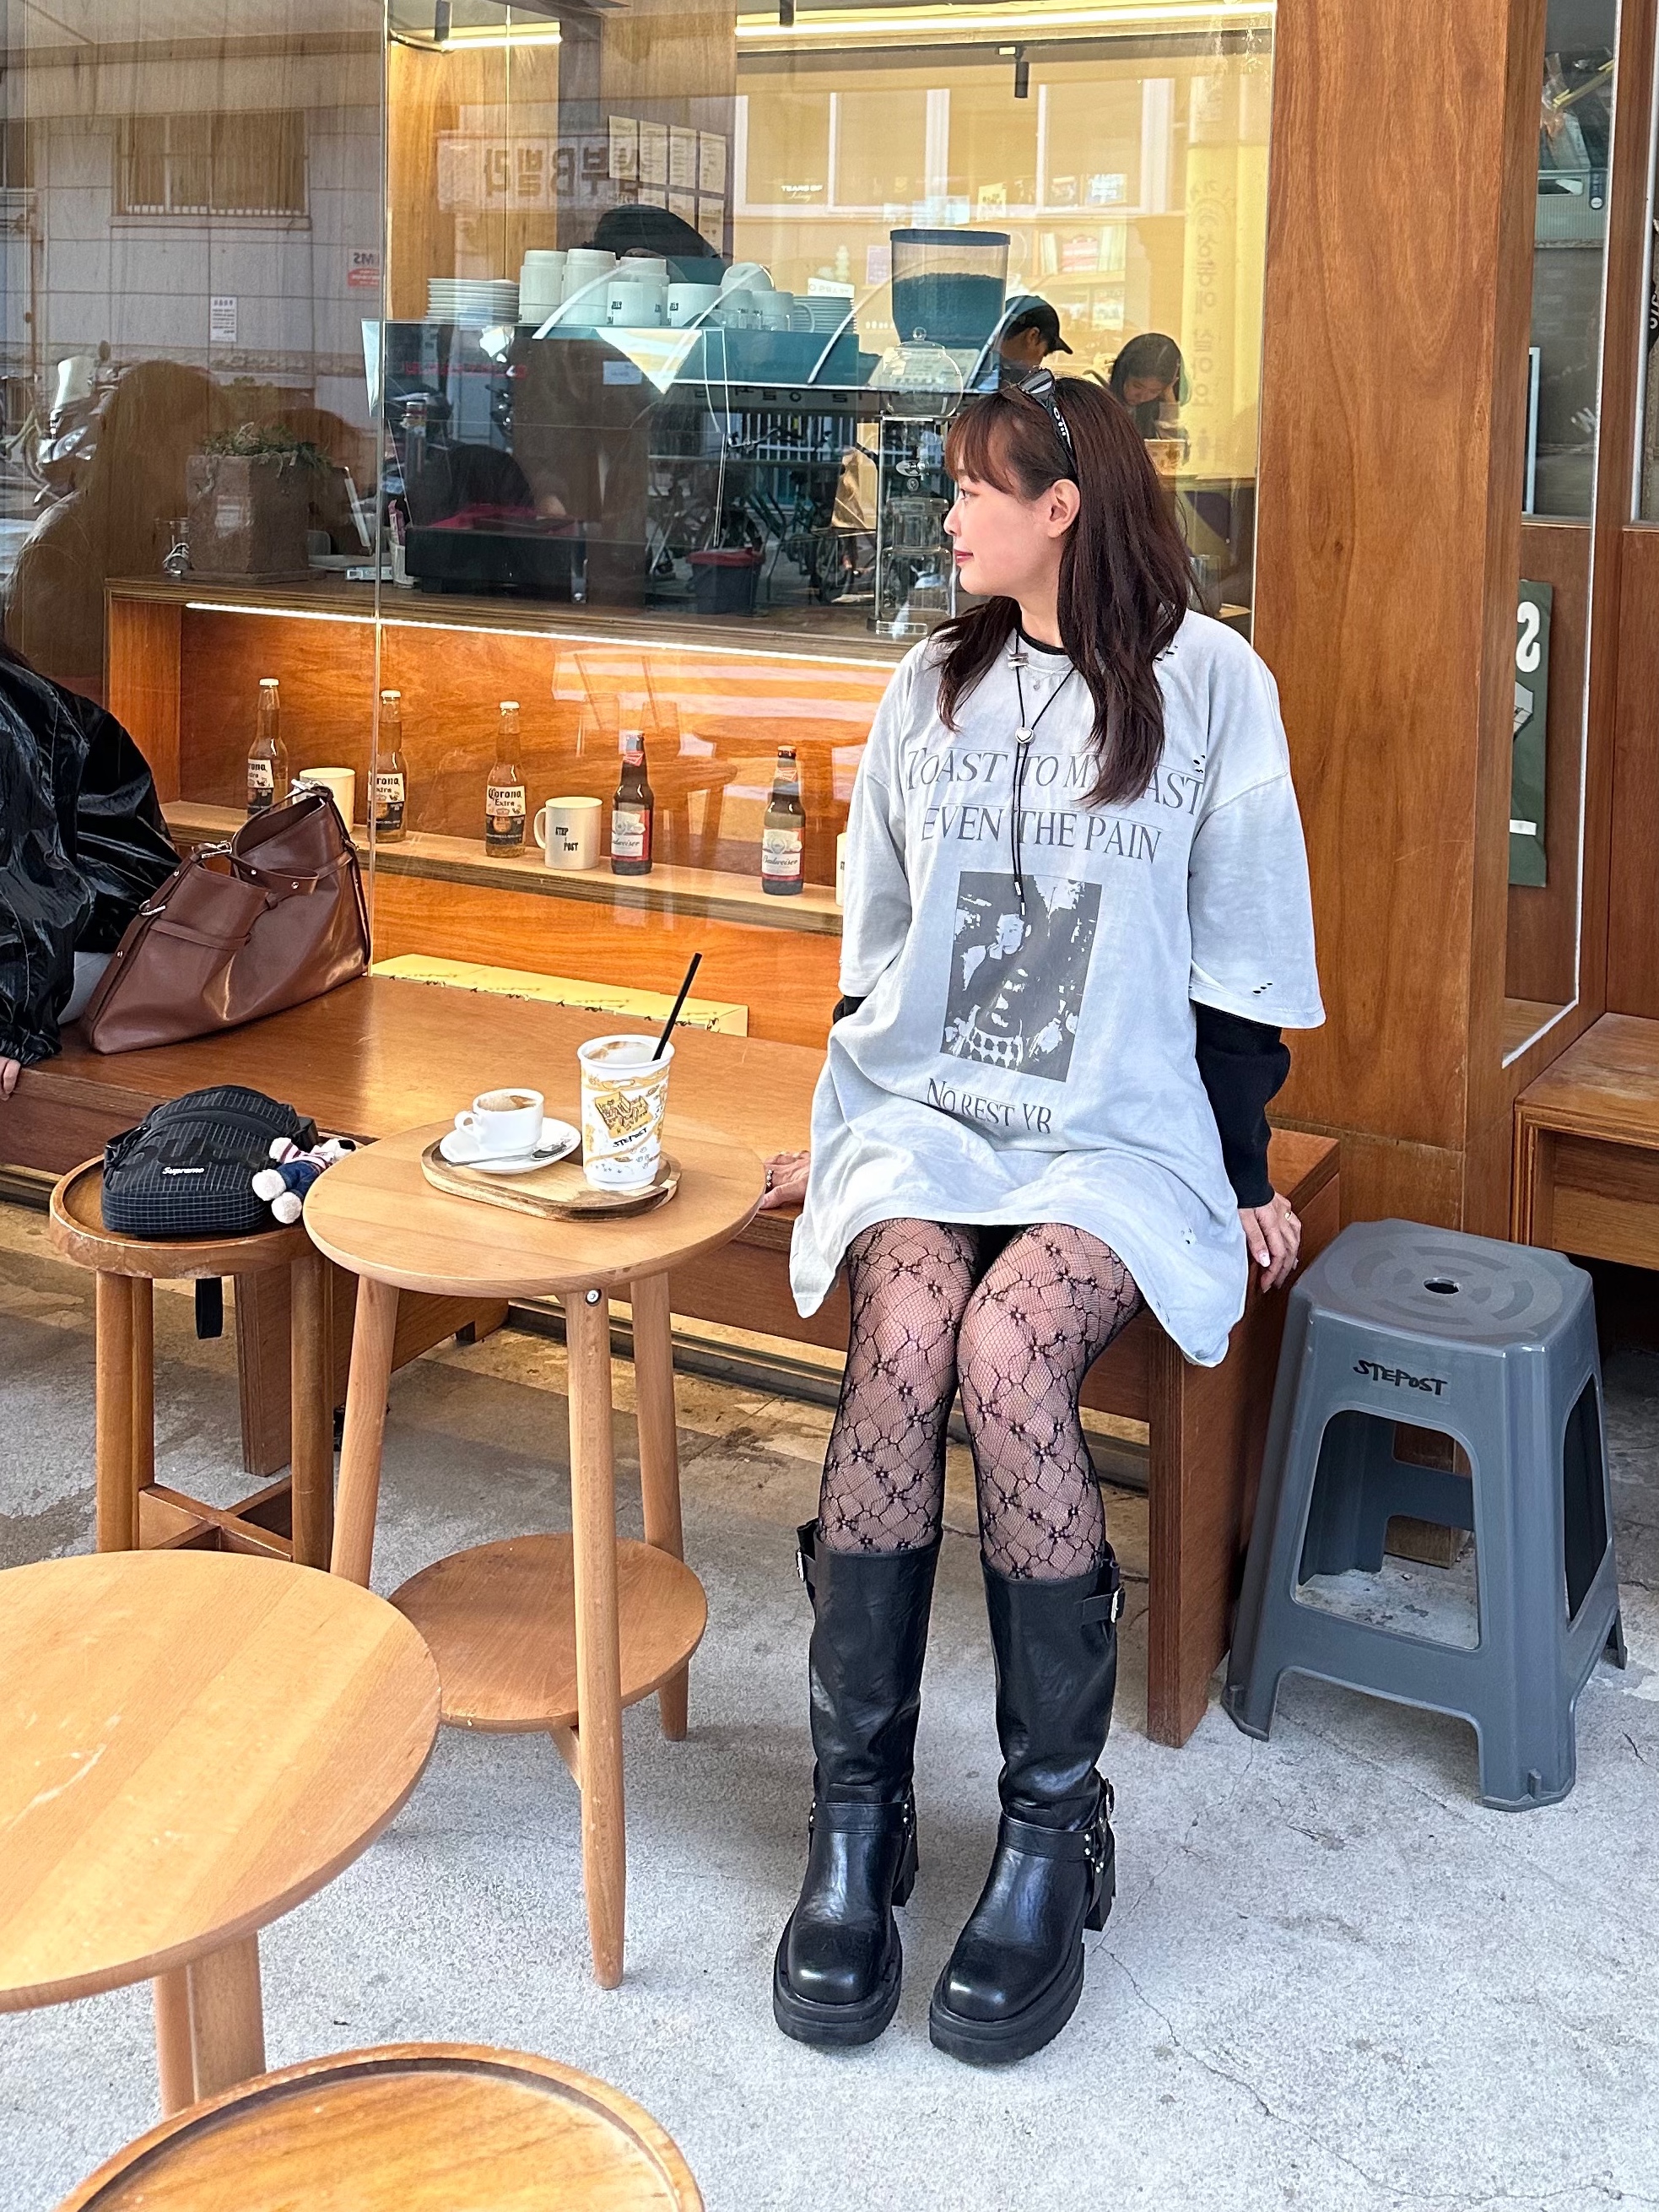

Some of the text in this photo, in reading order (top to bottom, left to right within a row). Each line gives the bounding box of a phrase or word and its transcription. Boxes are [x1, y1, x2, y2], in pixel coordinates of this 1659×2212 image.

[248, 763, 267, 771] rona
[905, 747, 1009, 790] TOAST
[1015, 754, 1060, 787] TO
[1141, 765, 1206, 816] AST
[488, 787, 522, 801] Corona
[494, 798, 515, 807] Extra
[921, 805, 1164, 864] EVEN THE PAIN
[763, 854, 798, 866] Budweiser
[927, 1078, 956, 1113] NO
[960, 1092, 1016, 1127] REST
[161, 1166, 205, 1176] Supreme
